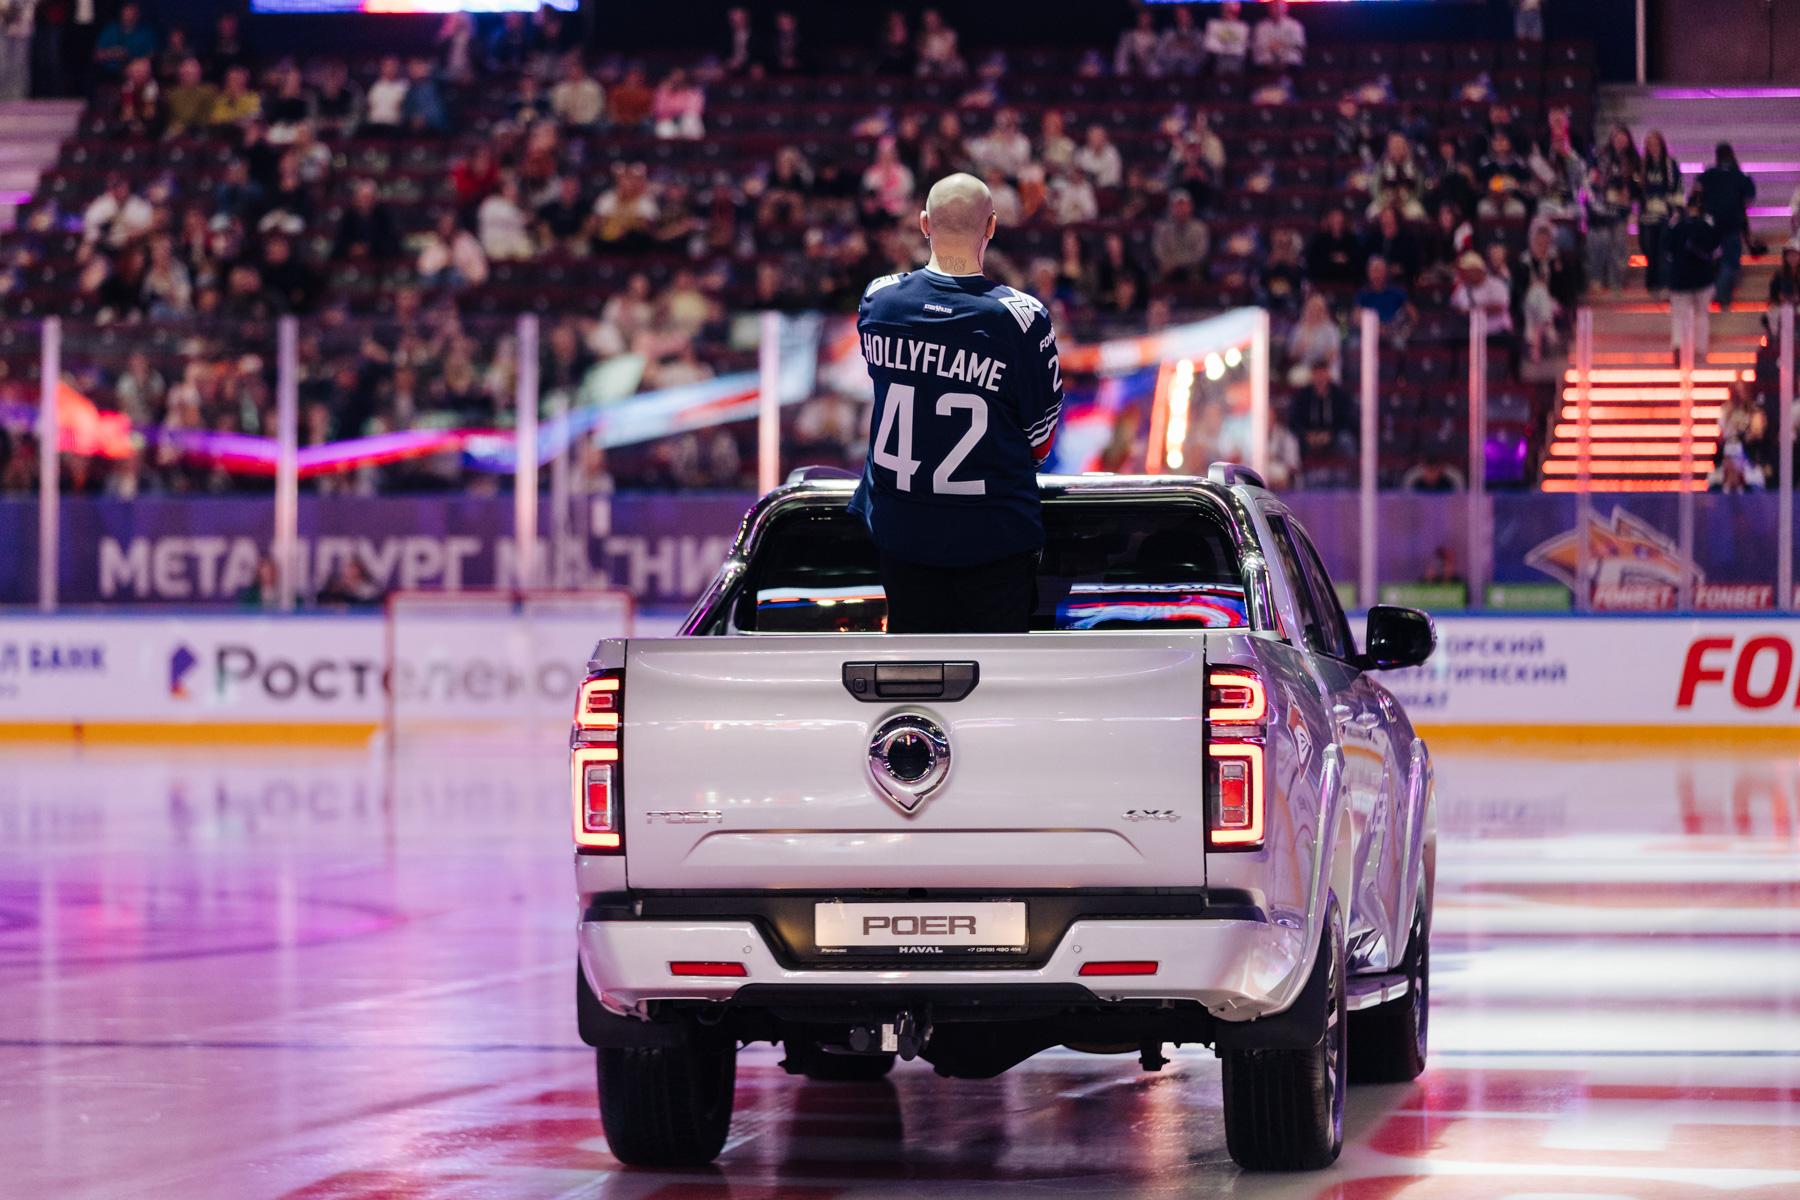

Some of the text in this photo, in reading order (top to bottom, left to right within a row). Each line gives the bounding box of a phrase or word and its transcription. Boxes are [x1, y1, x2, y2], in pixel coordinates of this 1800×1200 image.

[863, 332, 1006, 392] HOLLYFLAME
[874, 383, 989, 495] 42
[214, 645, 576, 700] Ростелеко
[1676, 634, 1800, 711] FO
[646, 810, 722, 824] POER
[863, 916, 976, 935] POER
